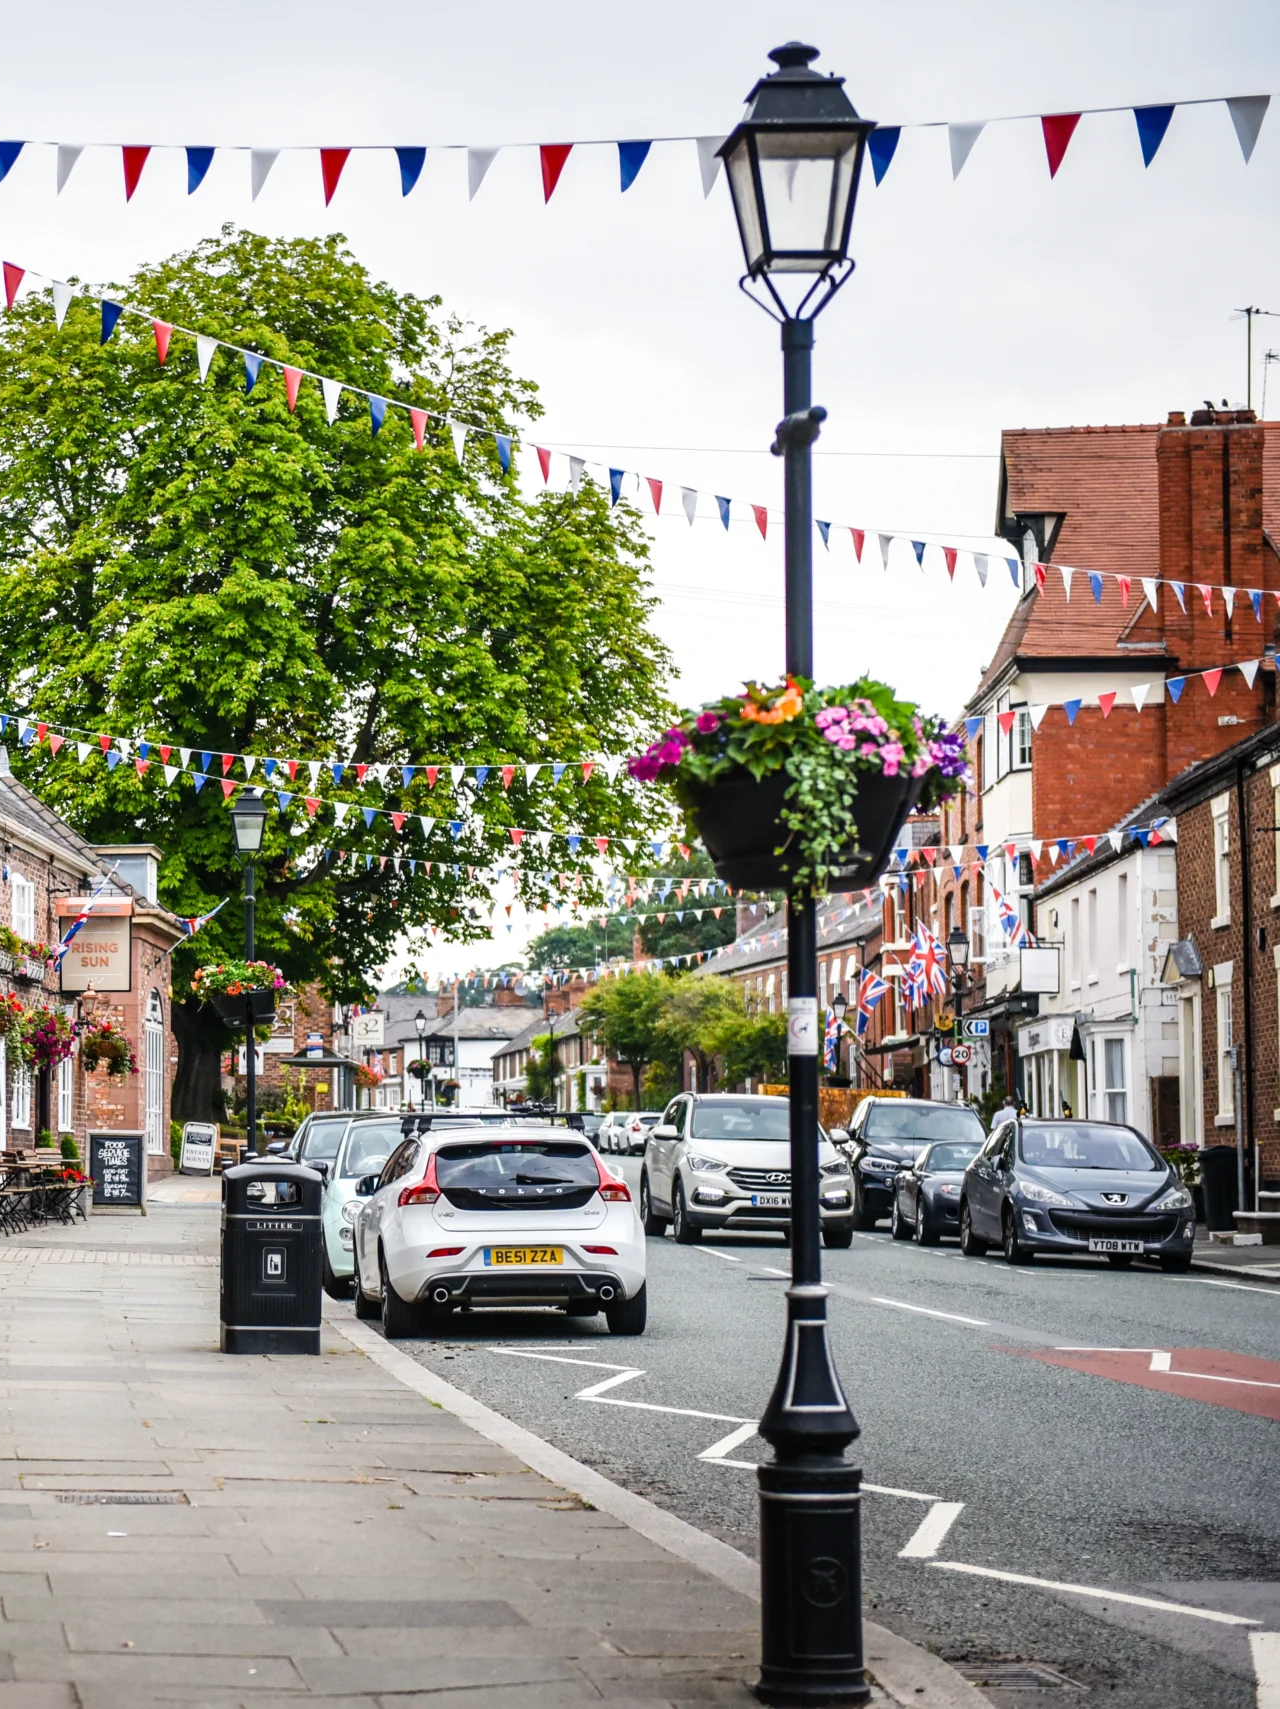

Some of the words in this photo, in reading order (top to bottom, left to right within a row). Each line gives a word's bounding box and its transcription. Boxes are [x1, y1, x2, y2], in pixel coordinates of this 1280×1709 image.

[71, 942, 119, 953] RISING
[81, 956, 109, 967] SUN
[357, 1018, 379, 1036] 32
[977, 1022, 986, 1034] P
[954, 1050, 969, 1059] 20
[105, 1141, 125, 1149] FOOD
[98, 1149, 130, 1158] SERVICE
[103, 1157, 127, 1165] TIMES
[104, 1174, 112, 1182] 12
[104, 1189, 111, 1197] 12
[760, 1196, 779, 1205] DX16
[1093, 1240, 1118, 1250] YT08
[496, 1250, 526, 1264] BE51
[530, 1250, 557, 1263] ZZA
